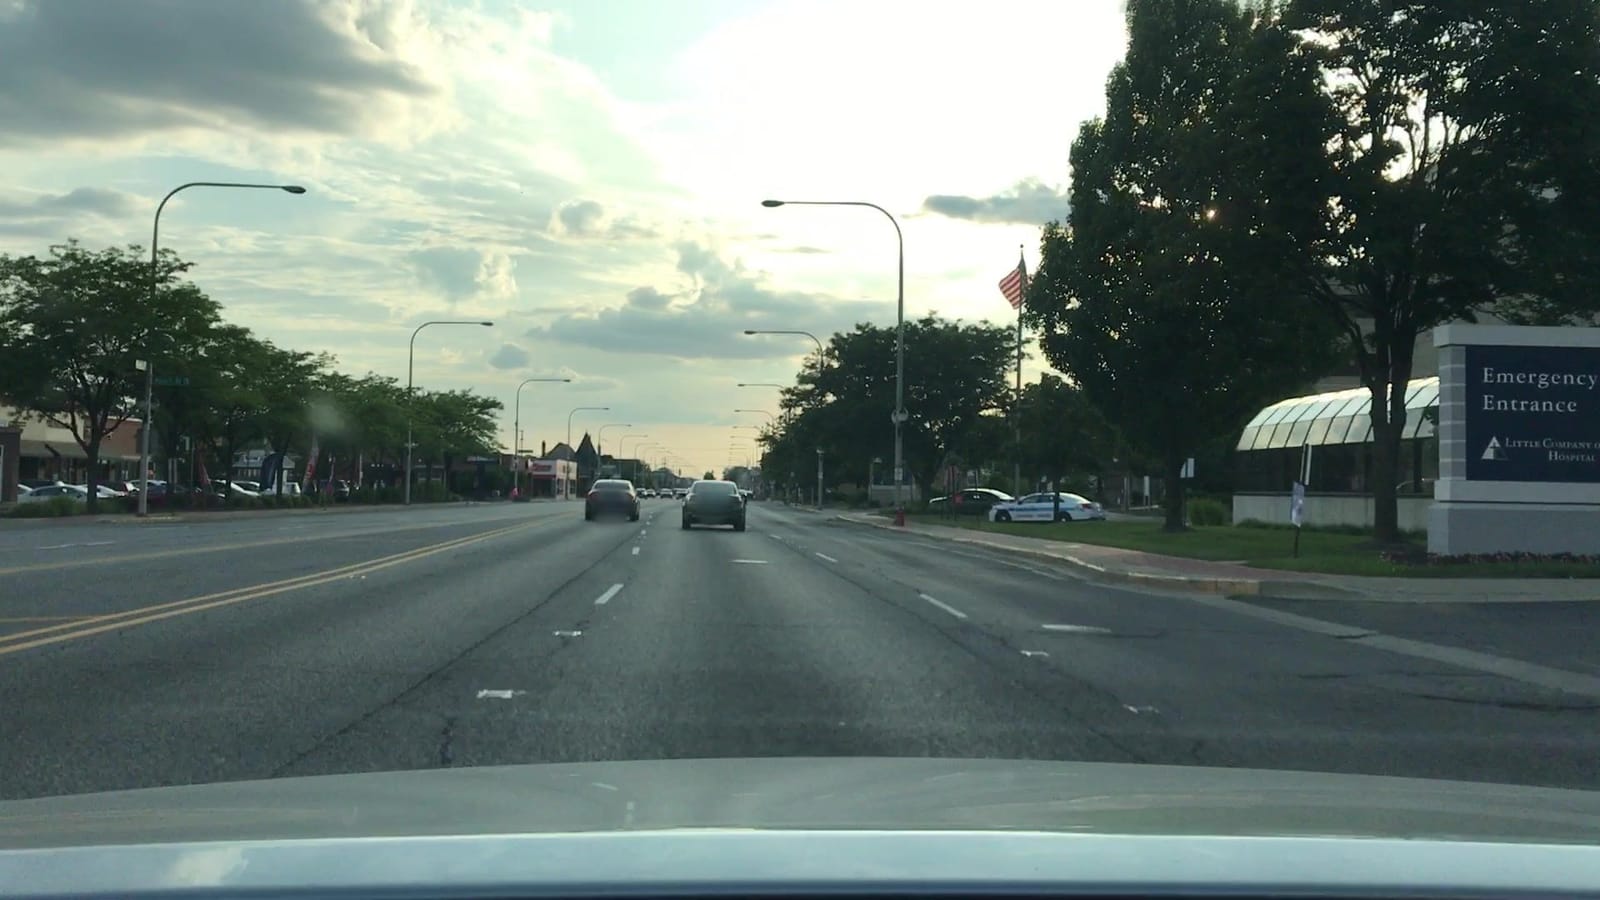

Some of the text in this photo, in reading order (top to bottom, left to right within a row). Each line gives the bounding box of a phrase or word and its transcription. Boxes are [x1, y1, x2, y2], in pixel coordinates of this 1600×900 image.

[1483, 367, 1598, 390] Emergency
[1483, 394, 1577, 412] Entrance
[1505, 437, 1540, 448] LITTLE
[1542, 437, 1593, 449] COMPANY
[1548, 450, 1595, 462] HOSPITAL
